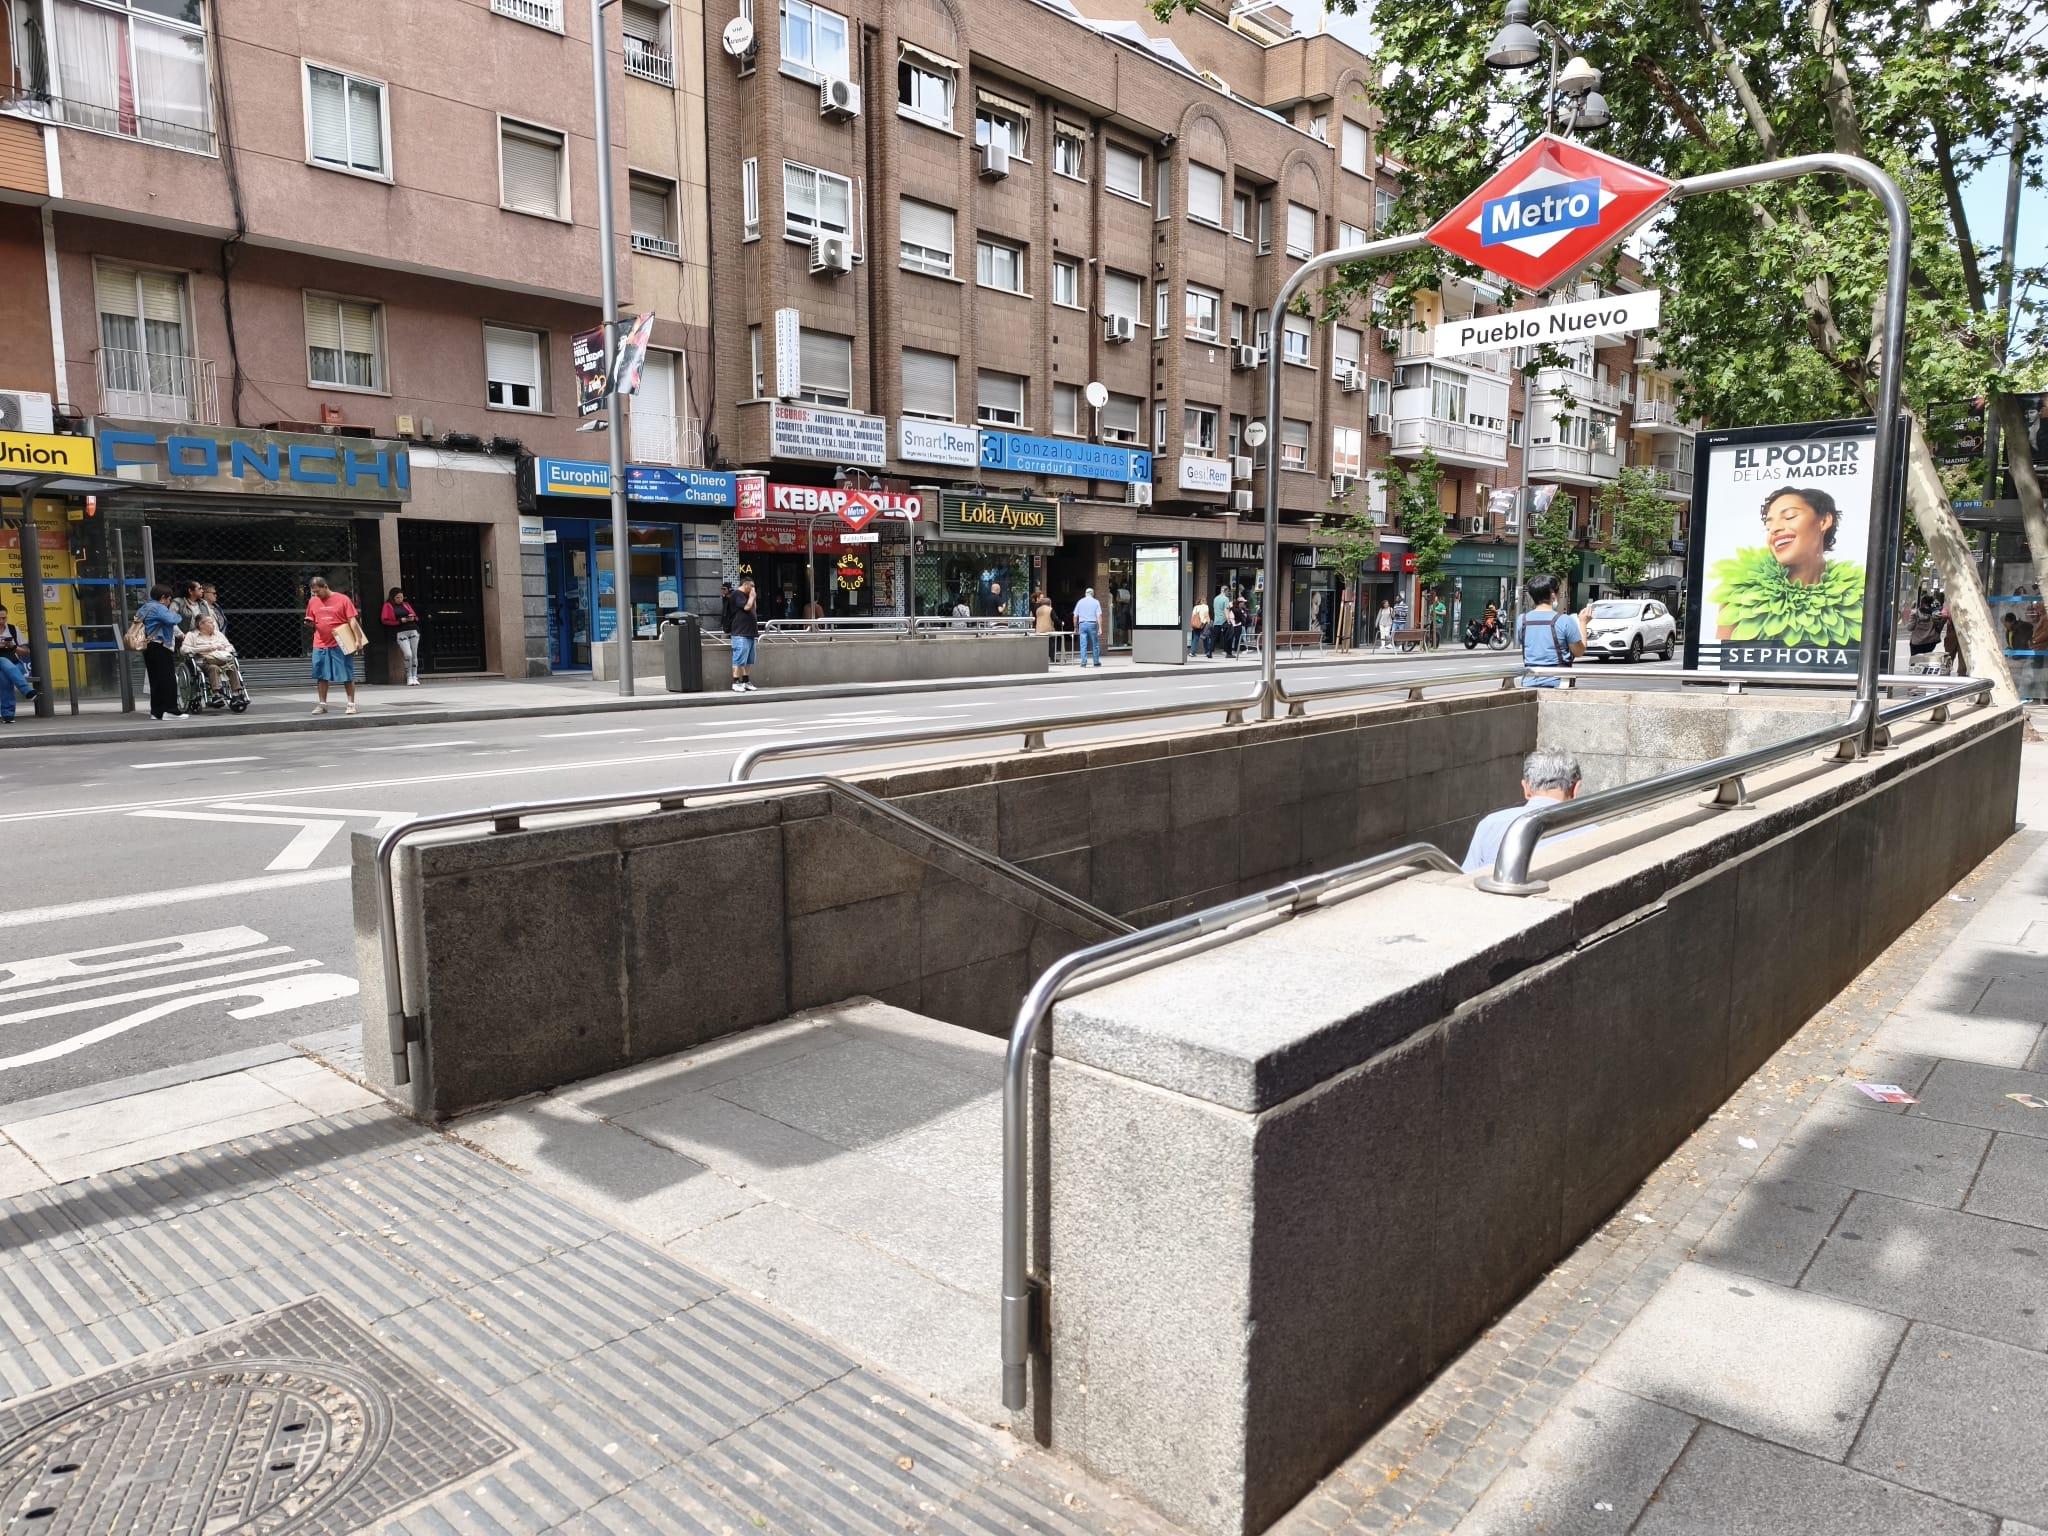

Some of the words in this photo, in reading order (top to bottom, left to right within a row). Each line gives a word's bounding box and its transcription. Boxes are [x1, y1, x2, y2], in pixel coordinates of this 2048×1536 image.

[1492, 193, 1590, 234] Metro
[1461, 319, 1541, 347] Pueblo
[1549, 308, 1628, 333] Nuevo
[1010, 438, 1072, 459] Gonzalo
[1078, 446, 1126, 466] Juanas
[1734, 449, 1760, 468] EL
[1766, 442, 1860, 467] PODER
[551, 466, 607, 485] Europhil
[690, 473, 727, 487] Dinero
[1016, 458, 1073, 474] Correduría
[1082, 464, 1120, 478] Seguros
[1734, 469, 1752, 482] DE
[1756, 468, 1781, 481] LAS
[1786, 462, 1858, 479] MADRES
[685, 489, 727, 504] Change
[773, 486, 846, 513] KEBAP
[858, 494, 921, 519] OLLO
[847, 508, 866, 517] Metro
[961, 502, 996, 525] Lola
[999, 504, 1044, 531] Ayuso
[836, 554, 864, 569] KEBAP
[837, 576, 864, 590] POLLOS
[1729, 648, 1848, 665] SEPHORA
[207, 1401, 274, 1521] REGISTRO
